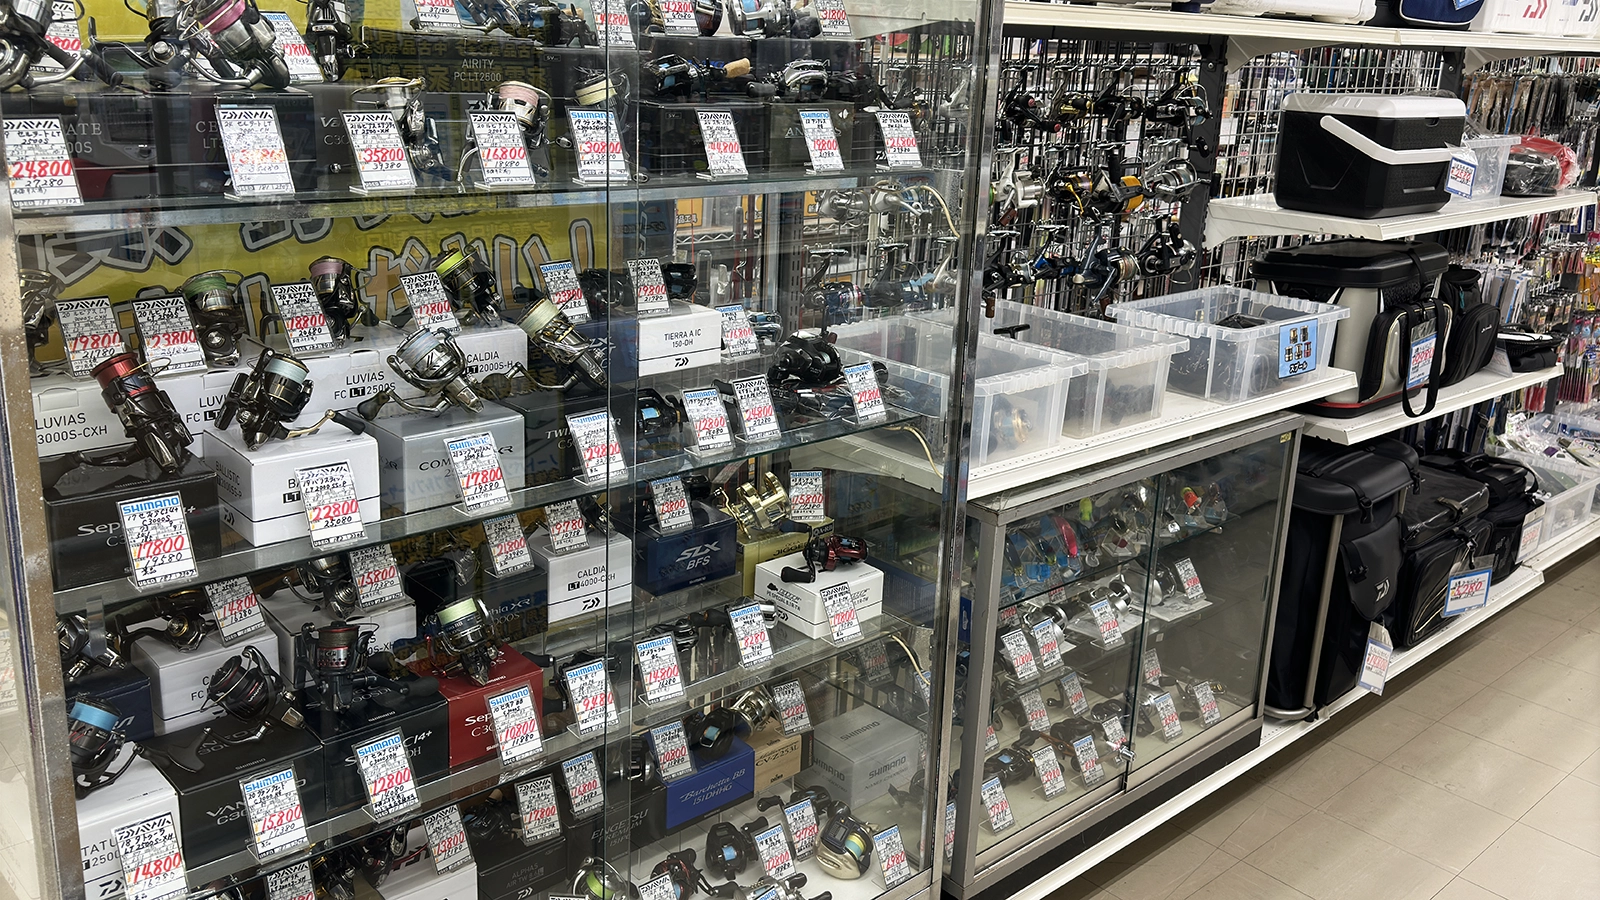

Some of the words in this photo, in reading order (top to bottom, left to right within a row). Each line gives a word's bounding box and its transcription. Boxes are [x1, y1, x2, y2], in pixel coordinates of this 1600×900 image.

[462, 58, 494, 69] AIRITY
[454, 72, 467, 82] PC
[58, 301, 110, 311] DAIWA
[135, 300, 184, 310] DAIWA
[664, 330, 688, 341] TIERRA
[466, 350, 500, 363] CALDIA
[1289, 361, 1308, 374] スプール
[346, 371, 385, 385] LUVIAS
[334, 390, 346, 400] FC
[685, 391, 718, 400] SHIMANO
[35, 412, 86, 430] LUVIAS
[186, 413, 200, 423] FC
[37, 424, 108, 445] 3000S-CXH
[122, 497, 179, 514] SHIMANO
[675, 541, 722, 562] SLX
[686, 555, 711, 571] BFS
[577, 565, 607, 579] CALDIA
[731, 606, 760, 618] SHIMANO
[638, 637, 672, 651] SHIMANO
[568, 662, 603, 679] SHIMANO
[191, 690, 204, 701] FC
[491, 688, 529, 707] SHIMANO
[653, 722, 683, 735] SHIMANO
[839, 721, 880, 742] SHIMANO
[358, 736, 401, 757] SHIMANO
[869, 756, 907, 780] SHIMANO
[245, 771, 293, 792] SHIMANO
[519, 777, 551, 792] DAIWA
[680, 776, 732, 801] Barchetta
[732, 768, 746, 780] BB
[425, 806, 457, 825] DAIWA
[118, 817, 171, 840] DAIWA
